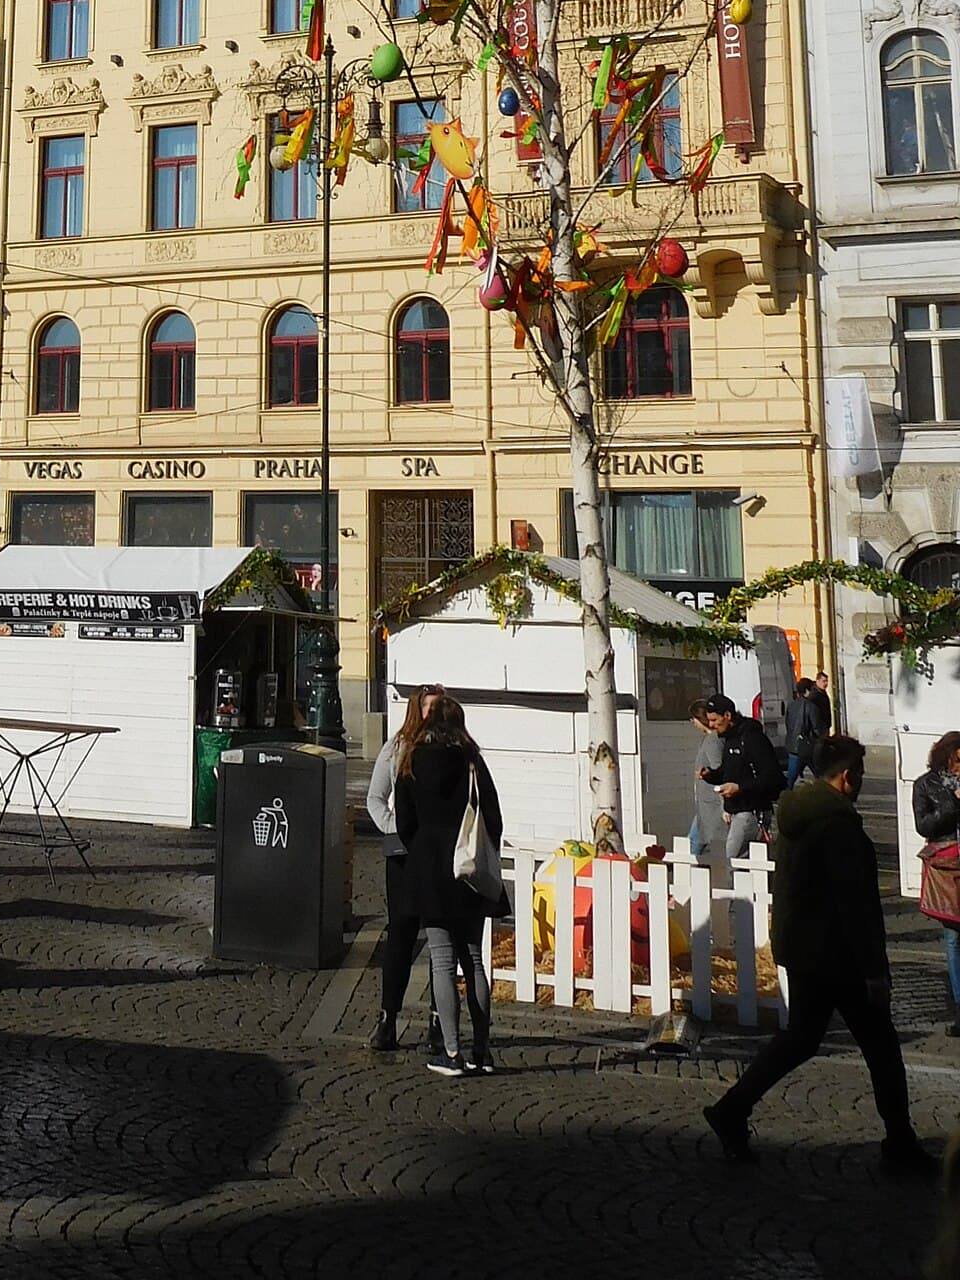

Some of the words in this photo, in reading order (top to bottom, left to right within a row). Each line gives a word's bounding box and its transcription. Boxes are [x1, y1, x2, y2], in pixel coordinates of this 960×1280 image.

[24, 461, 83, 480] VEGAS
[127, 460, 206, 479] CASINO
[254, 459, 322, 478] PRAHA
[402, 457, 441, 477] SPA
[598, 453, 704, 475] CHANGE
[56, 594, 68, 607] &
[69, 595, 98, 609] HOT
[98, 595, 152, 610] DRINKS
[62, 609, 69, 617] &
